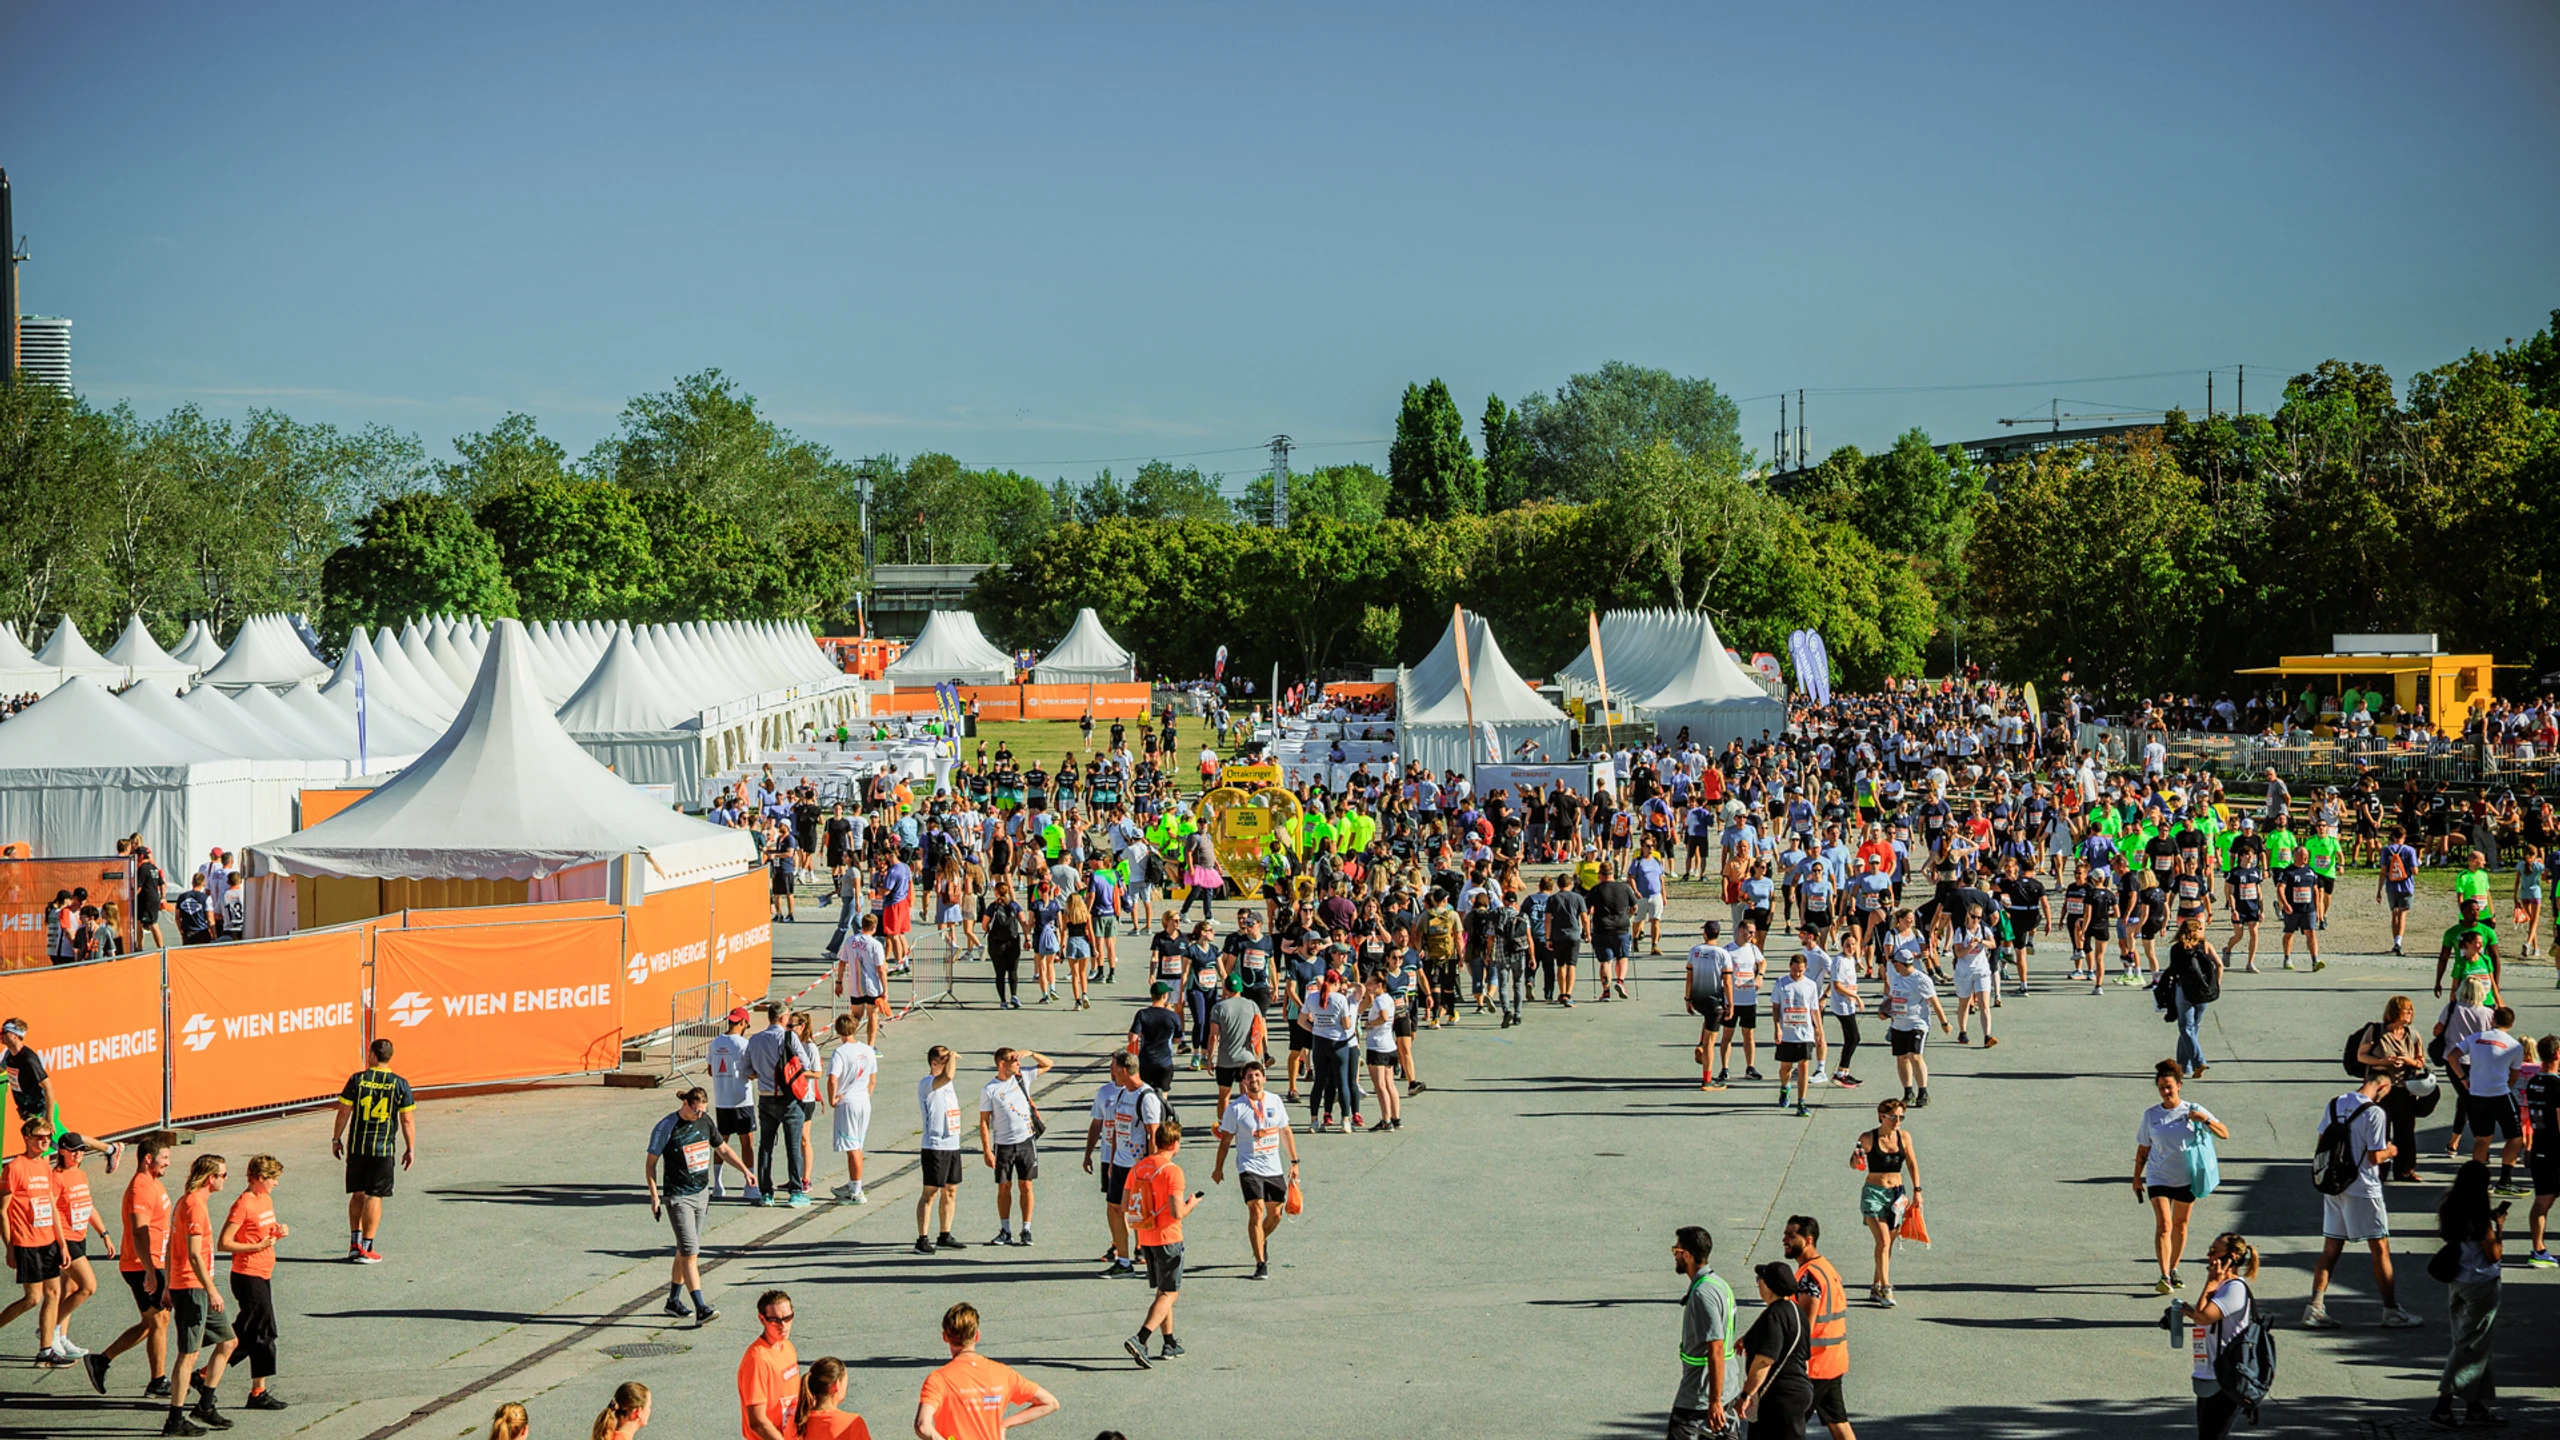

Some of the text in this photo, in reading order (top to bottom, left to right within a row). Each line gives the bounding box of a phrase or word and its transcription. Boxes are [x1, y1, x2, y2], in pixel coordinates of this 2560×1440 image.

[1226, 769, 1271, 779] Ottakringer
[225, 903, 242, 921] 13
[728, 923, 771, 954] WIEN ENERGIE
[650, 940, 707, 974] WIEN ENERGIE
[442, 984, 611, 1017] WIEN ENERGIE
[223, 1002, 354, 1040] WIEN ENERGIE
[38, 1029, 157, 1071] WIEN ENERGIE
[361, 1095, 389, 1122] 14
